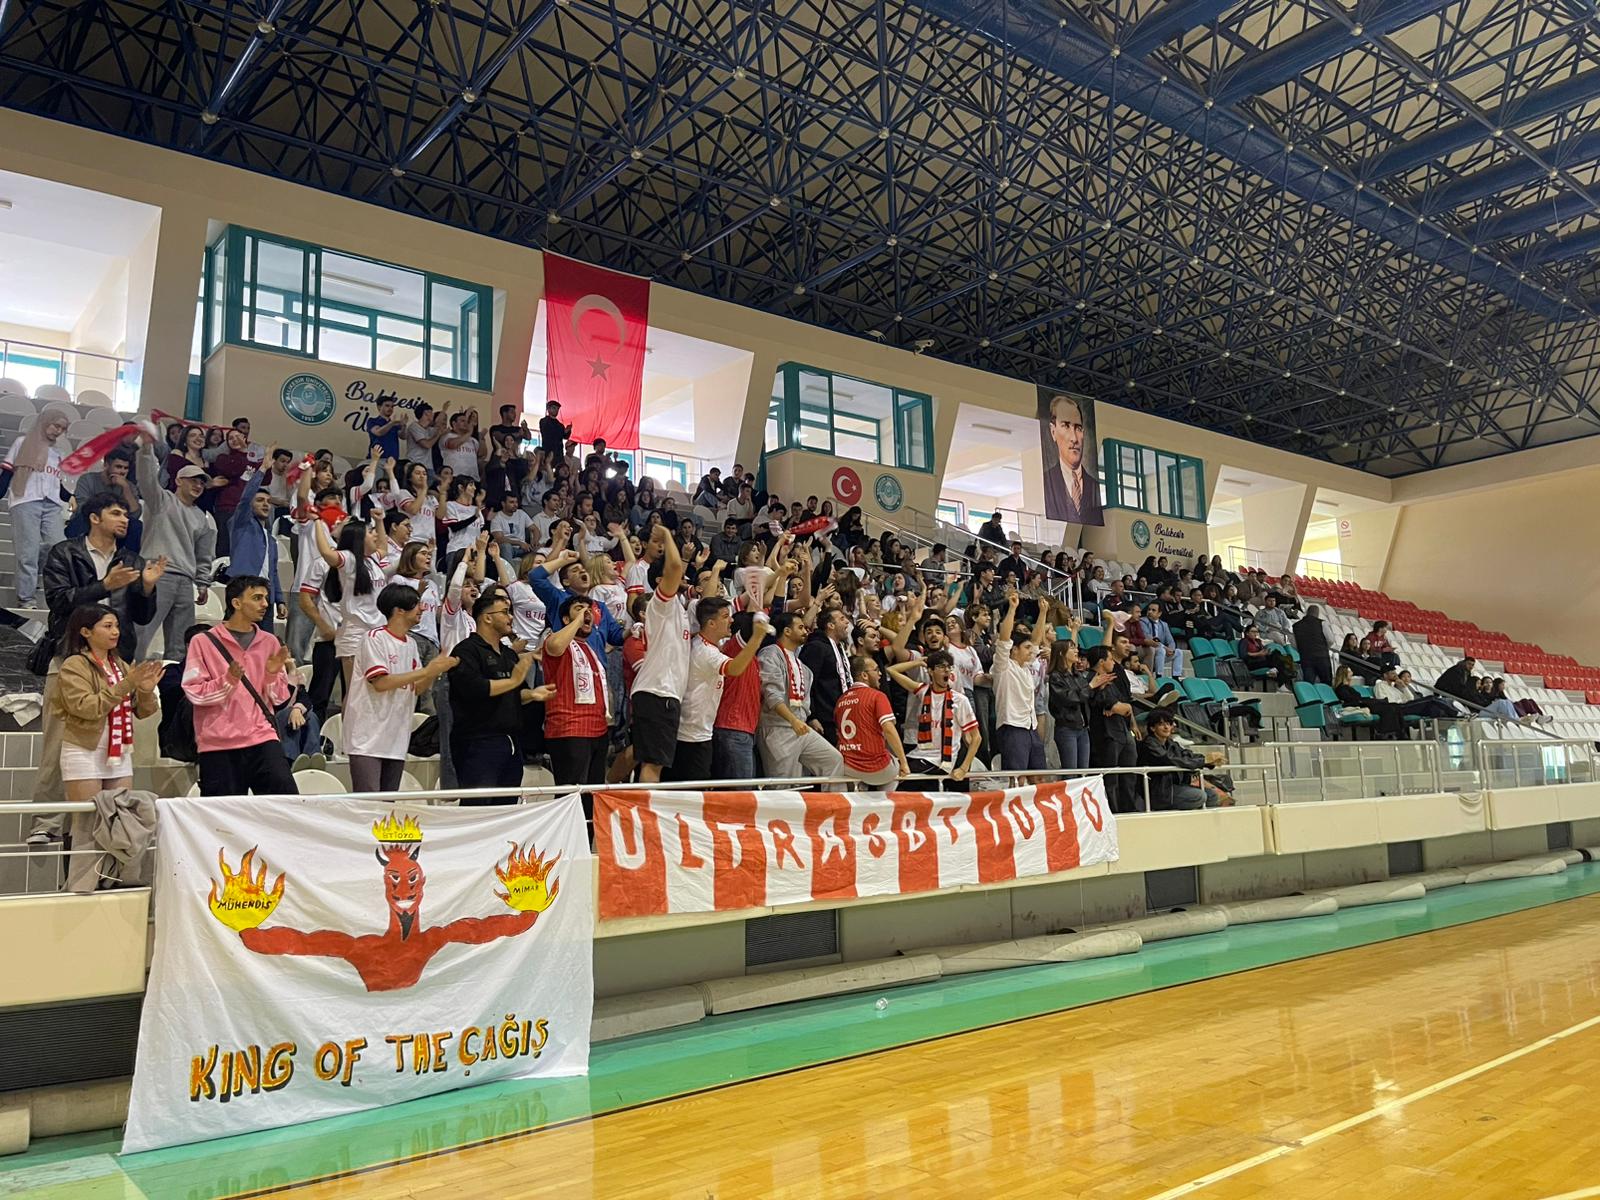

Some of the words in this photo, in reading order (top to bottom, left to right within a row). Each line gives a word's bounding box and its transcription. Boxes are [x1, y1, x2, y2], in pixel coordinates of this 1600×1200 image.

[840, 707, 857, 741] 6
[190, 1042, 298, 1103] KING
[313, 1036, 368, 1087] OF
[385, 1030, 453, 1075] THE
[457, 1012, 549, 1077] ÇAĞIŞ
